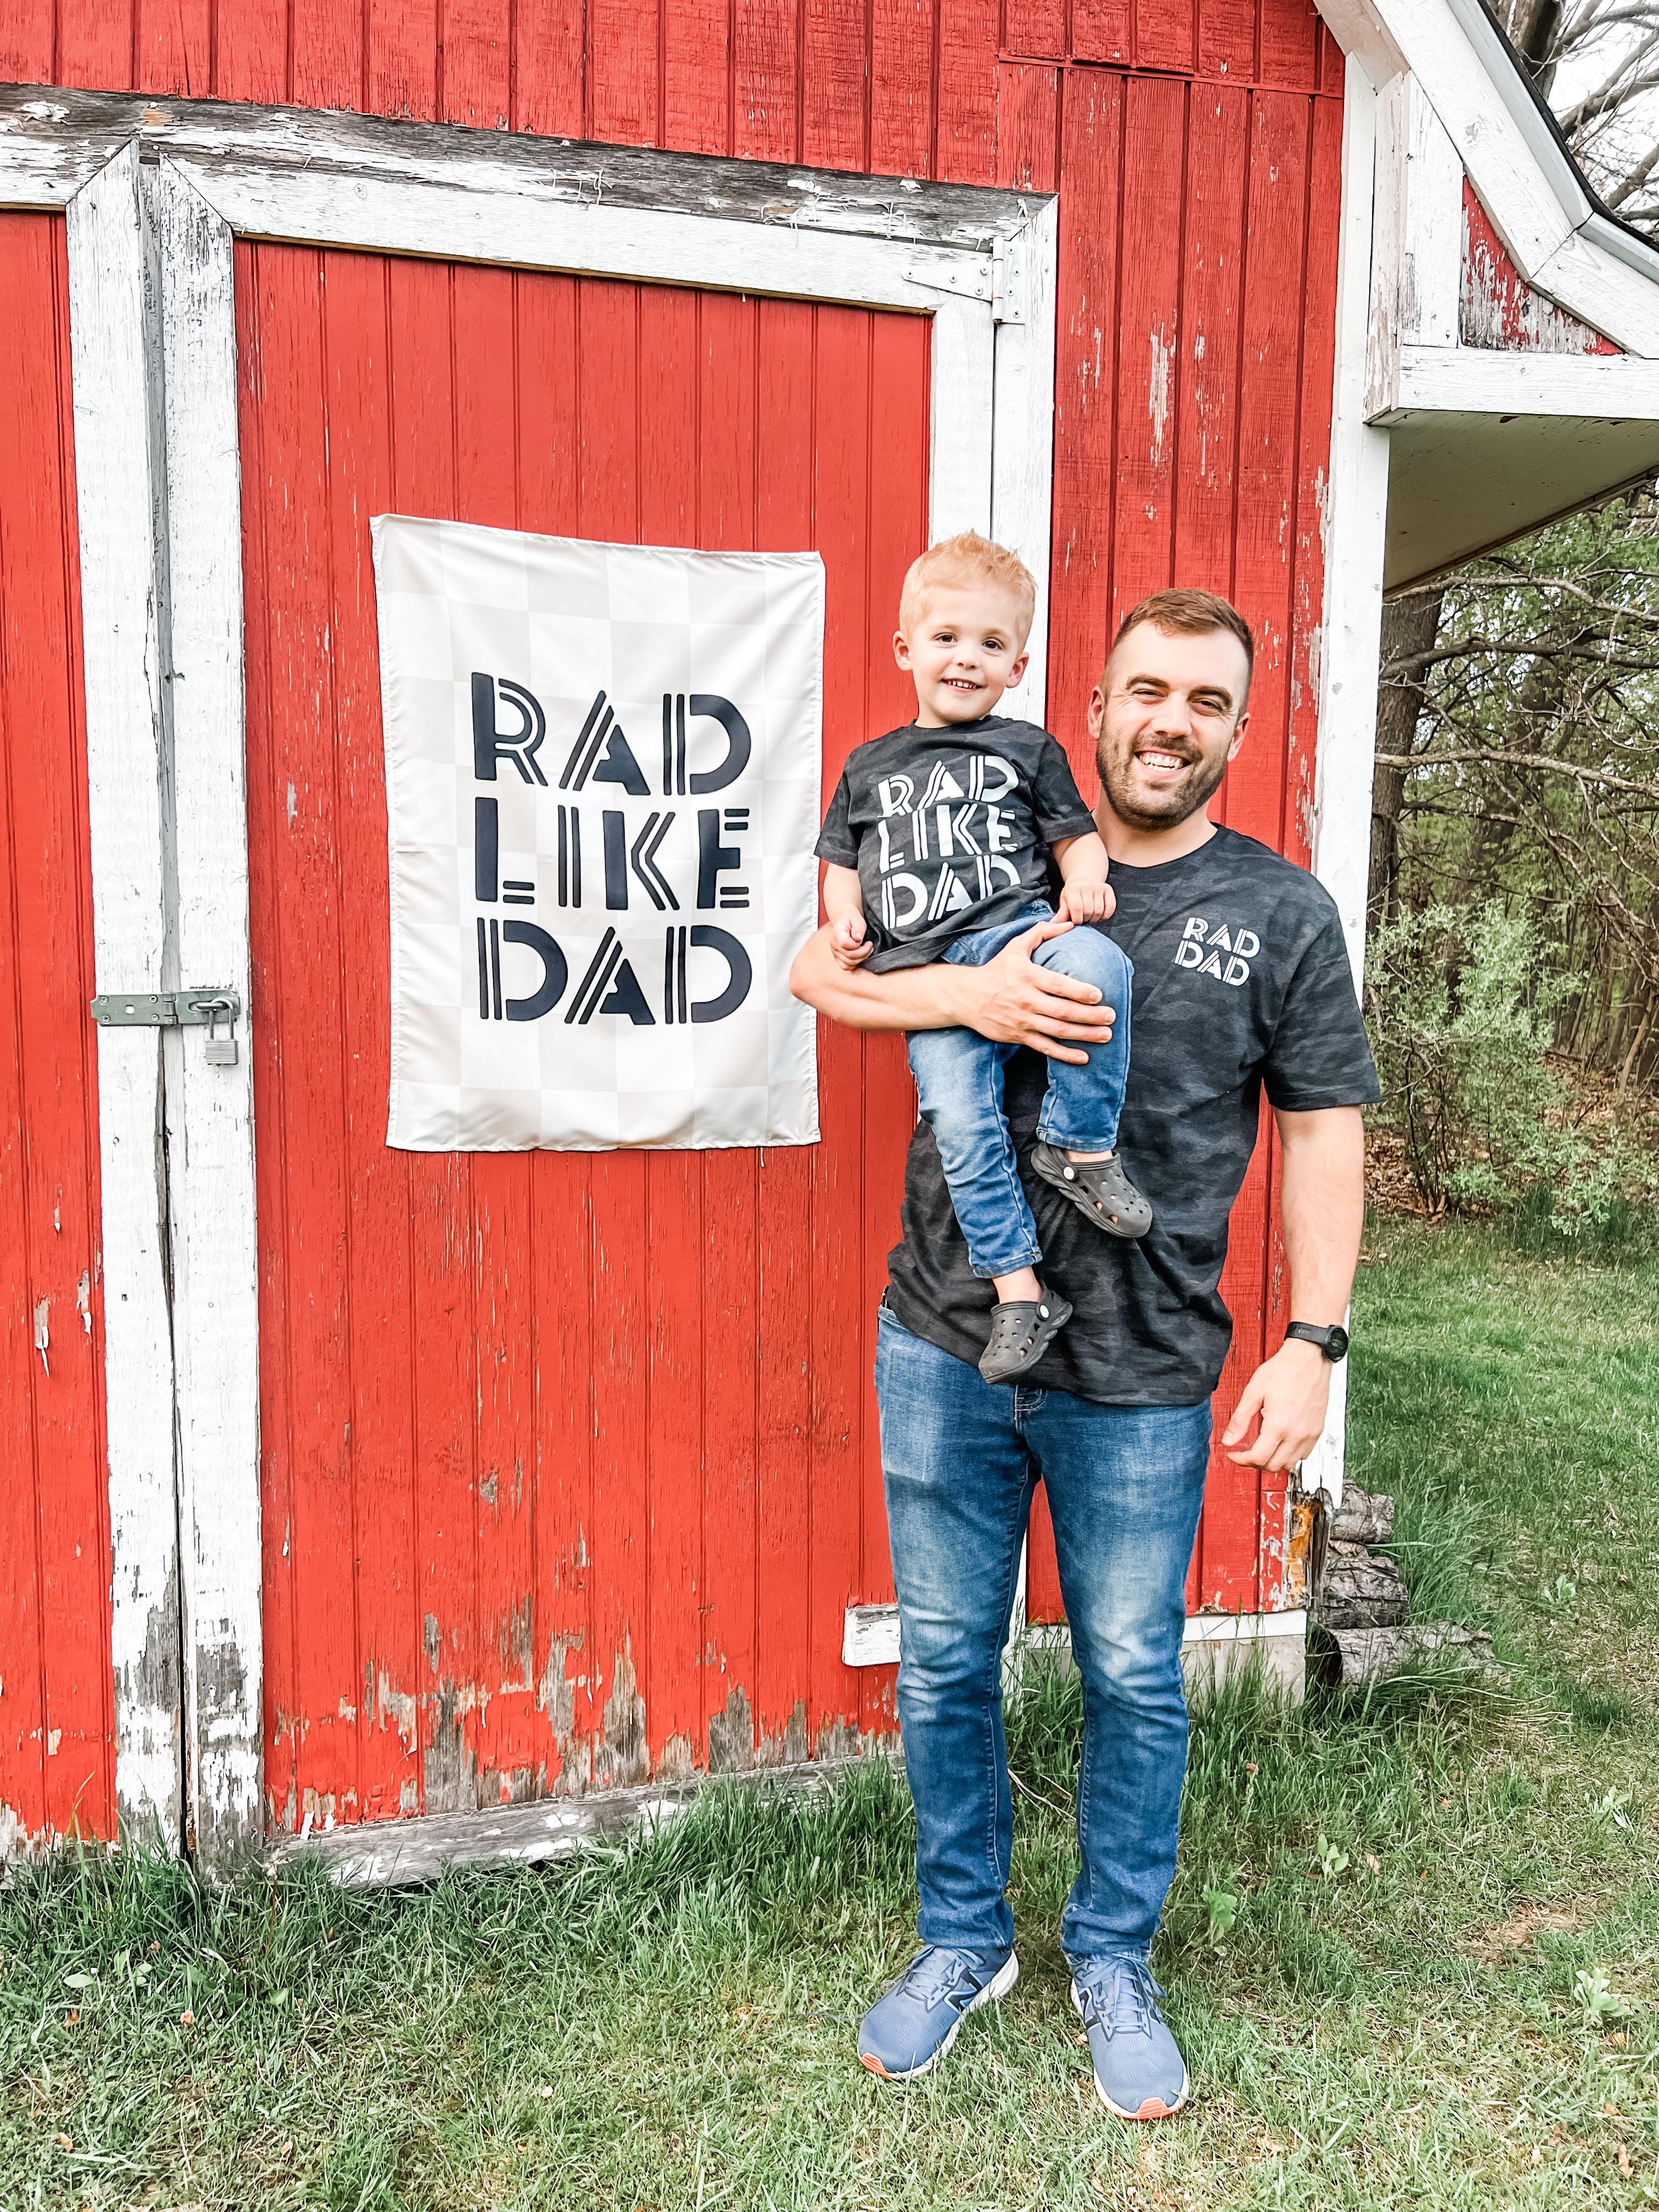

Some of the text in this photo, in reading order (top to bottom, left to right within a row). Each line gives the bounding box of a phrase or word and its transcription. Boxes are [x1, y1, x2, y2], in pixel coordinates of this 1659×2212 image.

[471, 672, 752, 796] RAD
[876, 755, 1019, 817] RAD
[475, 797, 750, 911] LIKE
[878, 803, 1018, 874] LIKE
[881, 854, 1021, 931] DAD
[477, 917, 753, 1026] DAD
[1174, 940, 1250, 986] DAD
[1182, 917, 1260, 958] RAD
